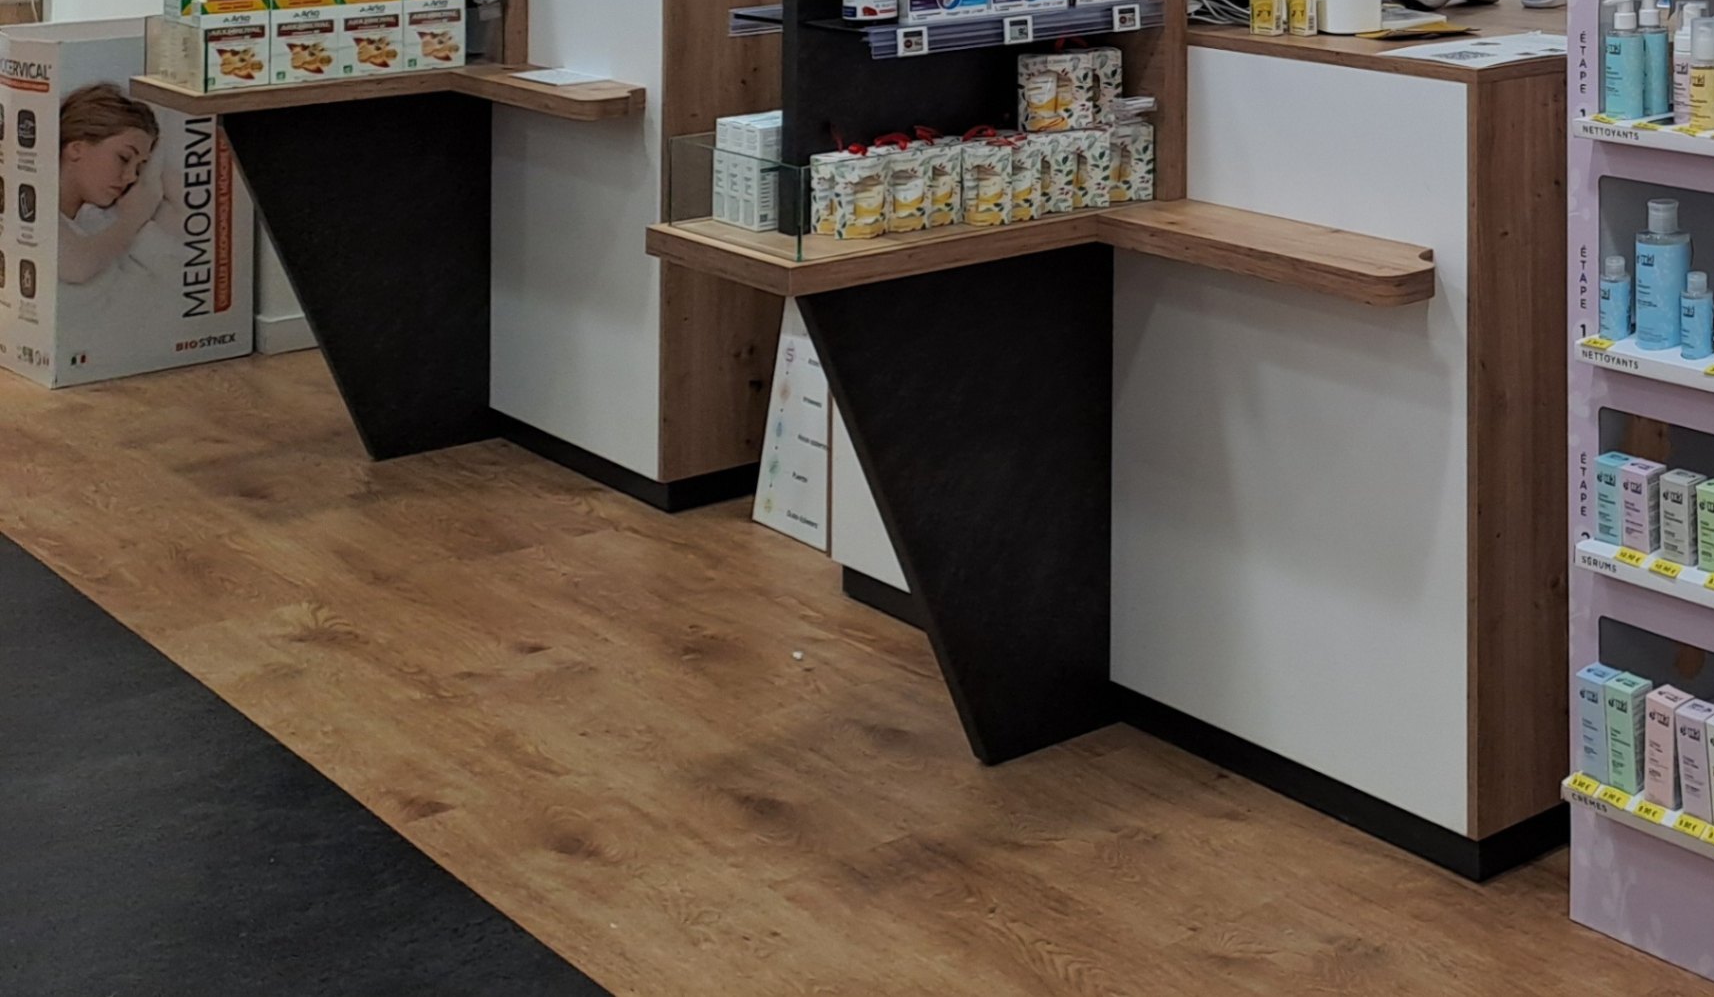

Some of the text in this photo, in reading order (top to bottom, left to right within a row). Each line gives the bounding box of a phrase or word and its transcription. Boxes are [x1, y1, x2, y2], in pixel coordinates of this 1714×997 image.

[1582, 125, 1640, 141] NETTOYANTS
[175, 331, 236, 352] BIOSYNEX
[1581, 349, 1640, 370] NETTOYANTS
[1581, 555, 1617, 574] SÉRUMS
